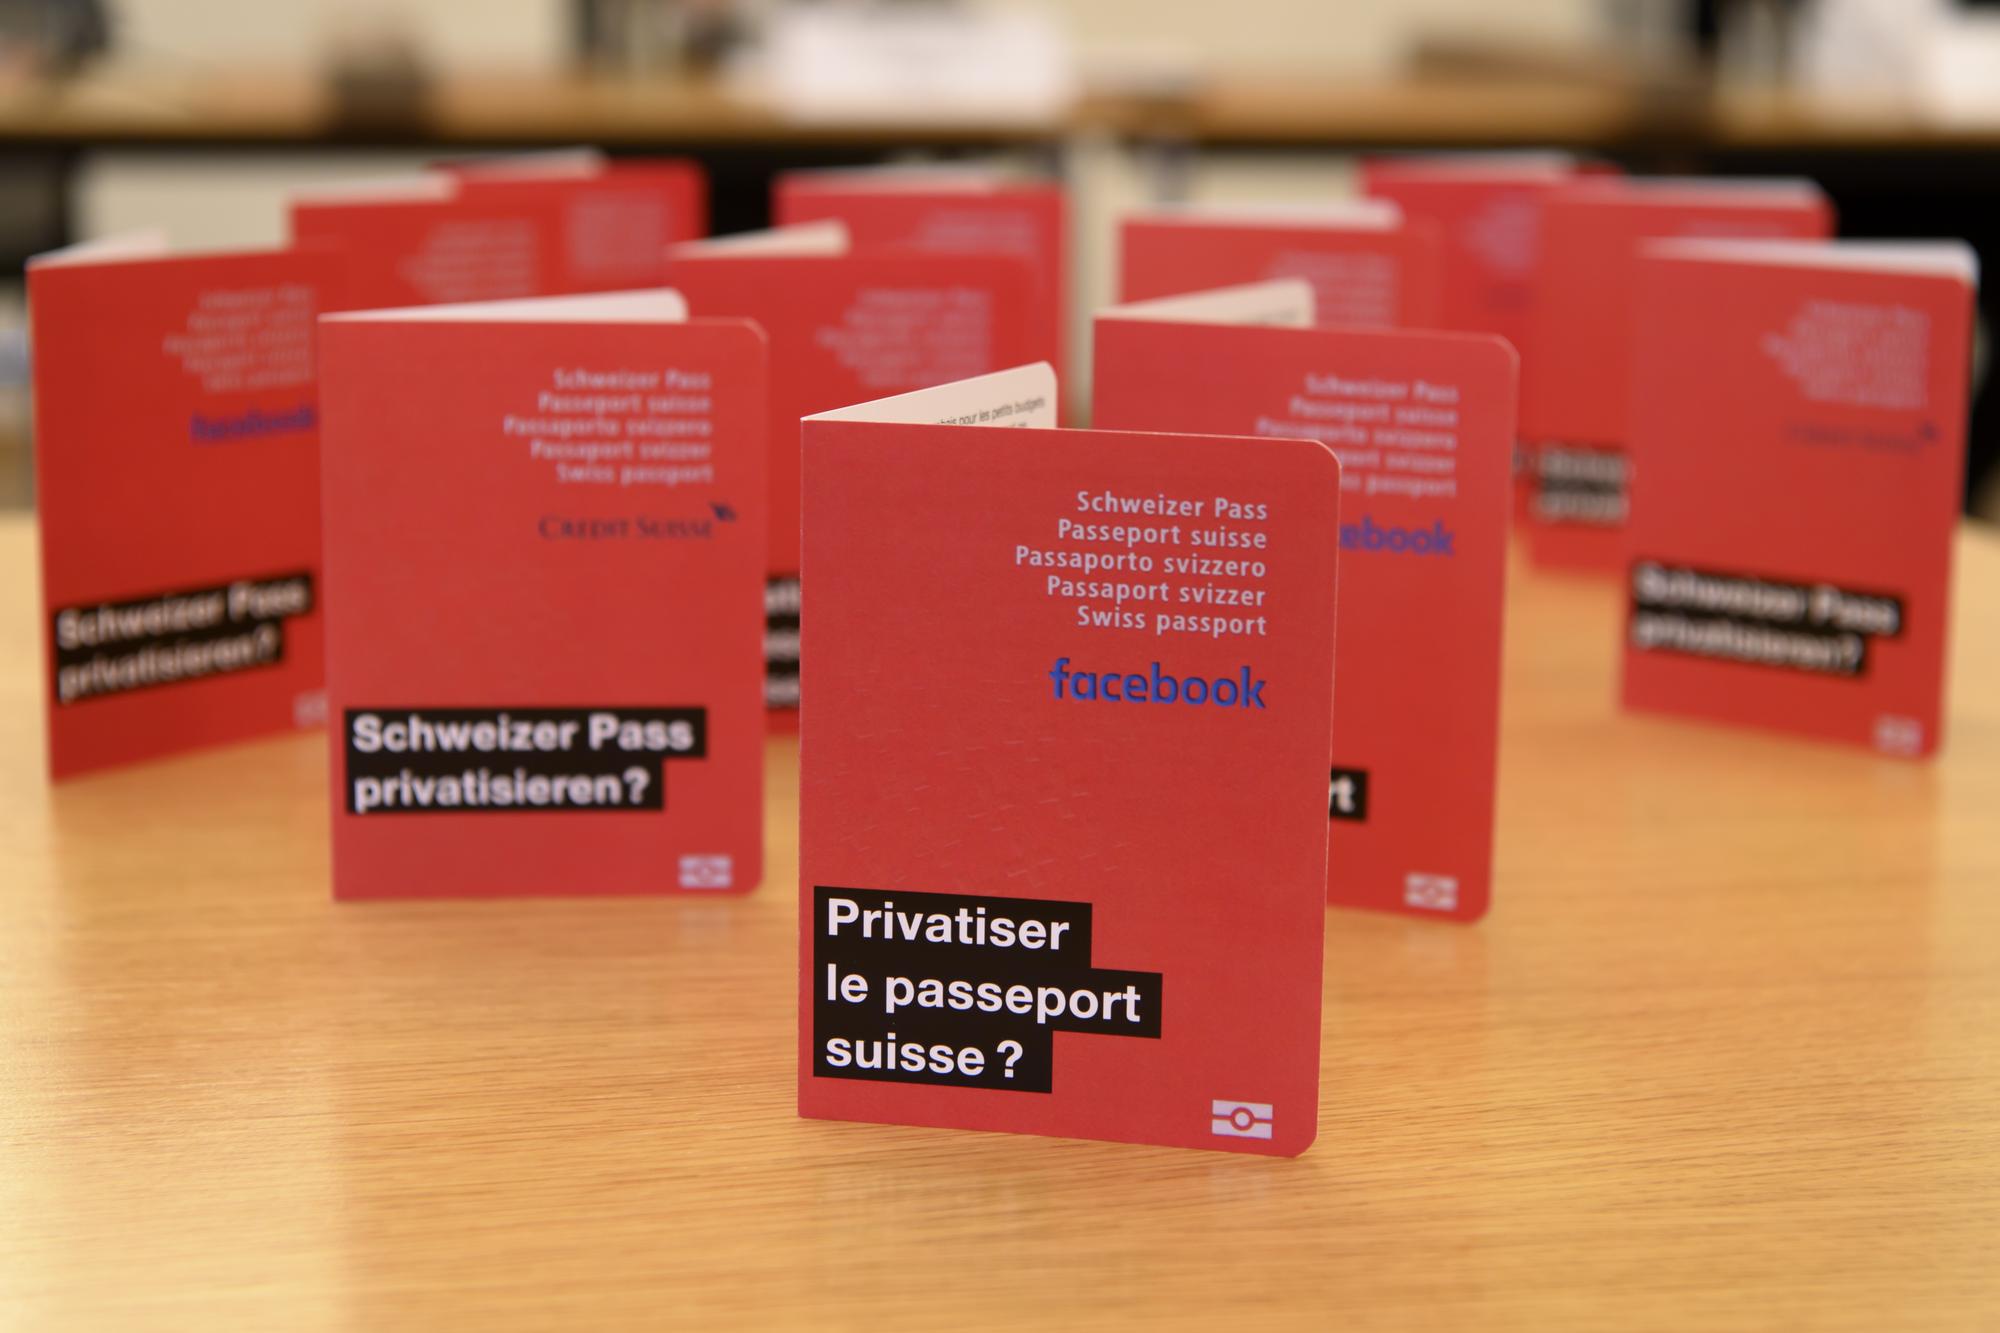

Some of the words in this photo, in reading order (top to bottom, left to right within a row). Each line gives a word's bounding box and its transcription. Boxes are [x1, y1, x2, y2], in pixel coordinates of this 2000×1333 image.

[665, 369, 711, 390] Pass
[1077, 490, 1204, 517] Schweizer
[1214, 497, 1268, 520] Pass
[1058, 518, 1181, 548] Passeport
[1191, 526, 1267, 549] suisse
[1340, 515, 1455, 557] ebook
[1015, 545, 1153, 575] Passaporto
[1163, 553, 1266, 578] svizzero
[227, 578, 308, 621] Pass
[1047, 575, 1169, 605] Passaport
[1179, 583, 1266, 607] svizzer
[1077, 605, 1146, 629] Swiss
[1156, 614, 1266, 638] passport
[1049, 656, 1267, 709] facebook
[353, 713, 579, 752] Schweizer
[588, 713, 694, 751] Pass
[354, 766, 650, 814] privatisieren?
[827, 897, 1070, 951] Privatiser
[827, 963, 869, 1003] le
[885, 975, 1141, 1025] passeport
[826, 1032, 985, 1077] suisse
